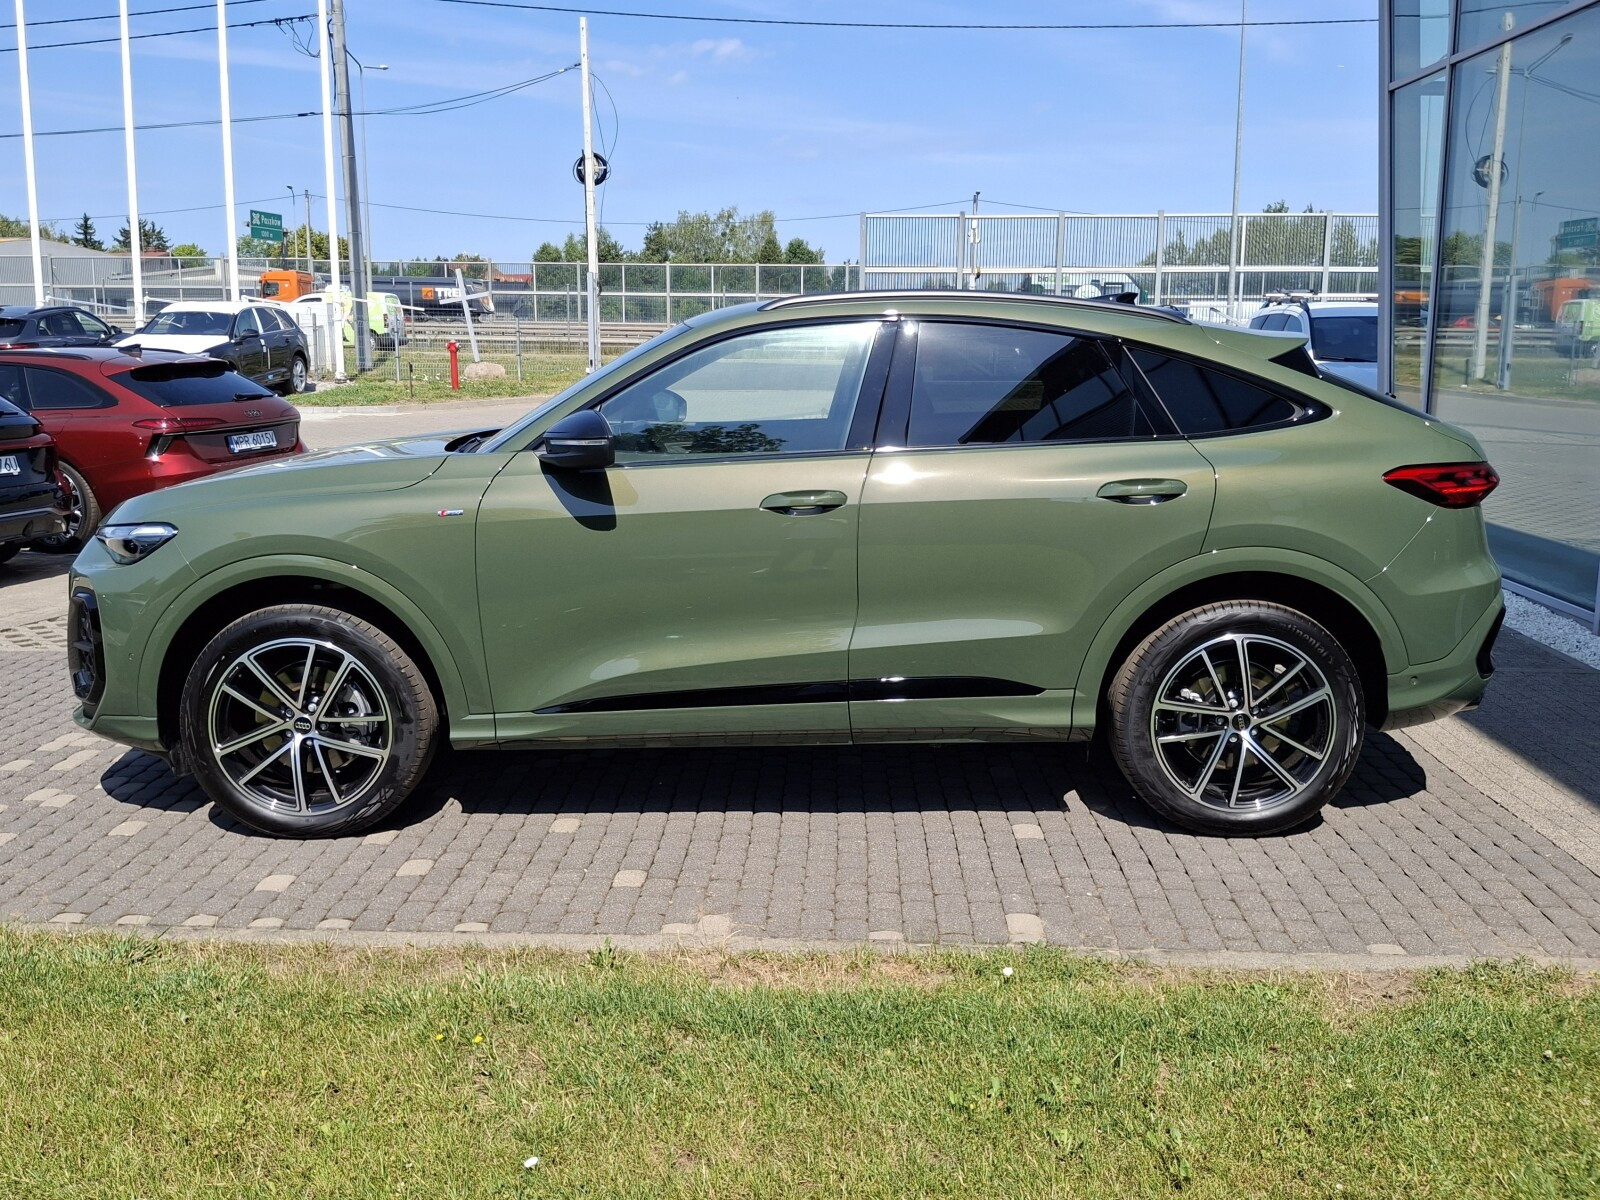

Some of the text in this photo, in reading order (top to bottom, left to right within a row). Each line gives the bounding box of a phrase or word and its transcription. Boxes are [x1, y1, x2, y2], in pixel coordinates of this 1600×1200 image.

[233, 432, 274, 448] WPR 6015V
[0, 457, 18, 471] 6U
